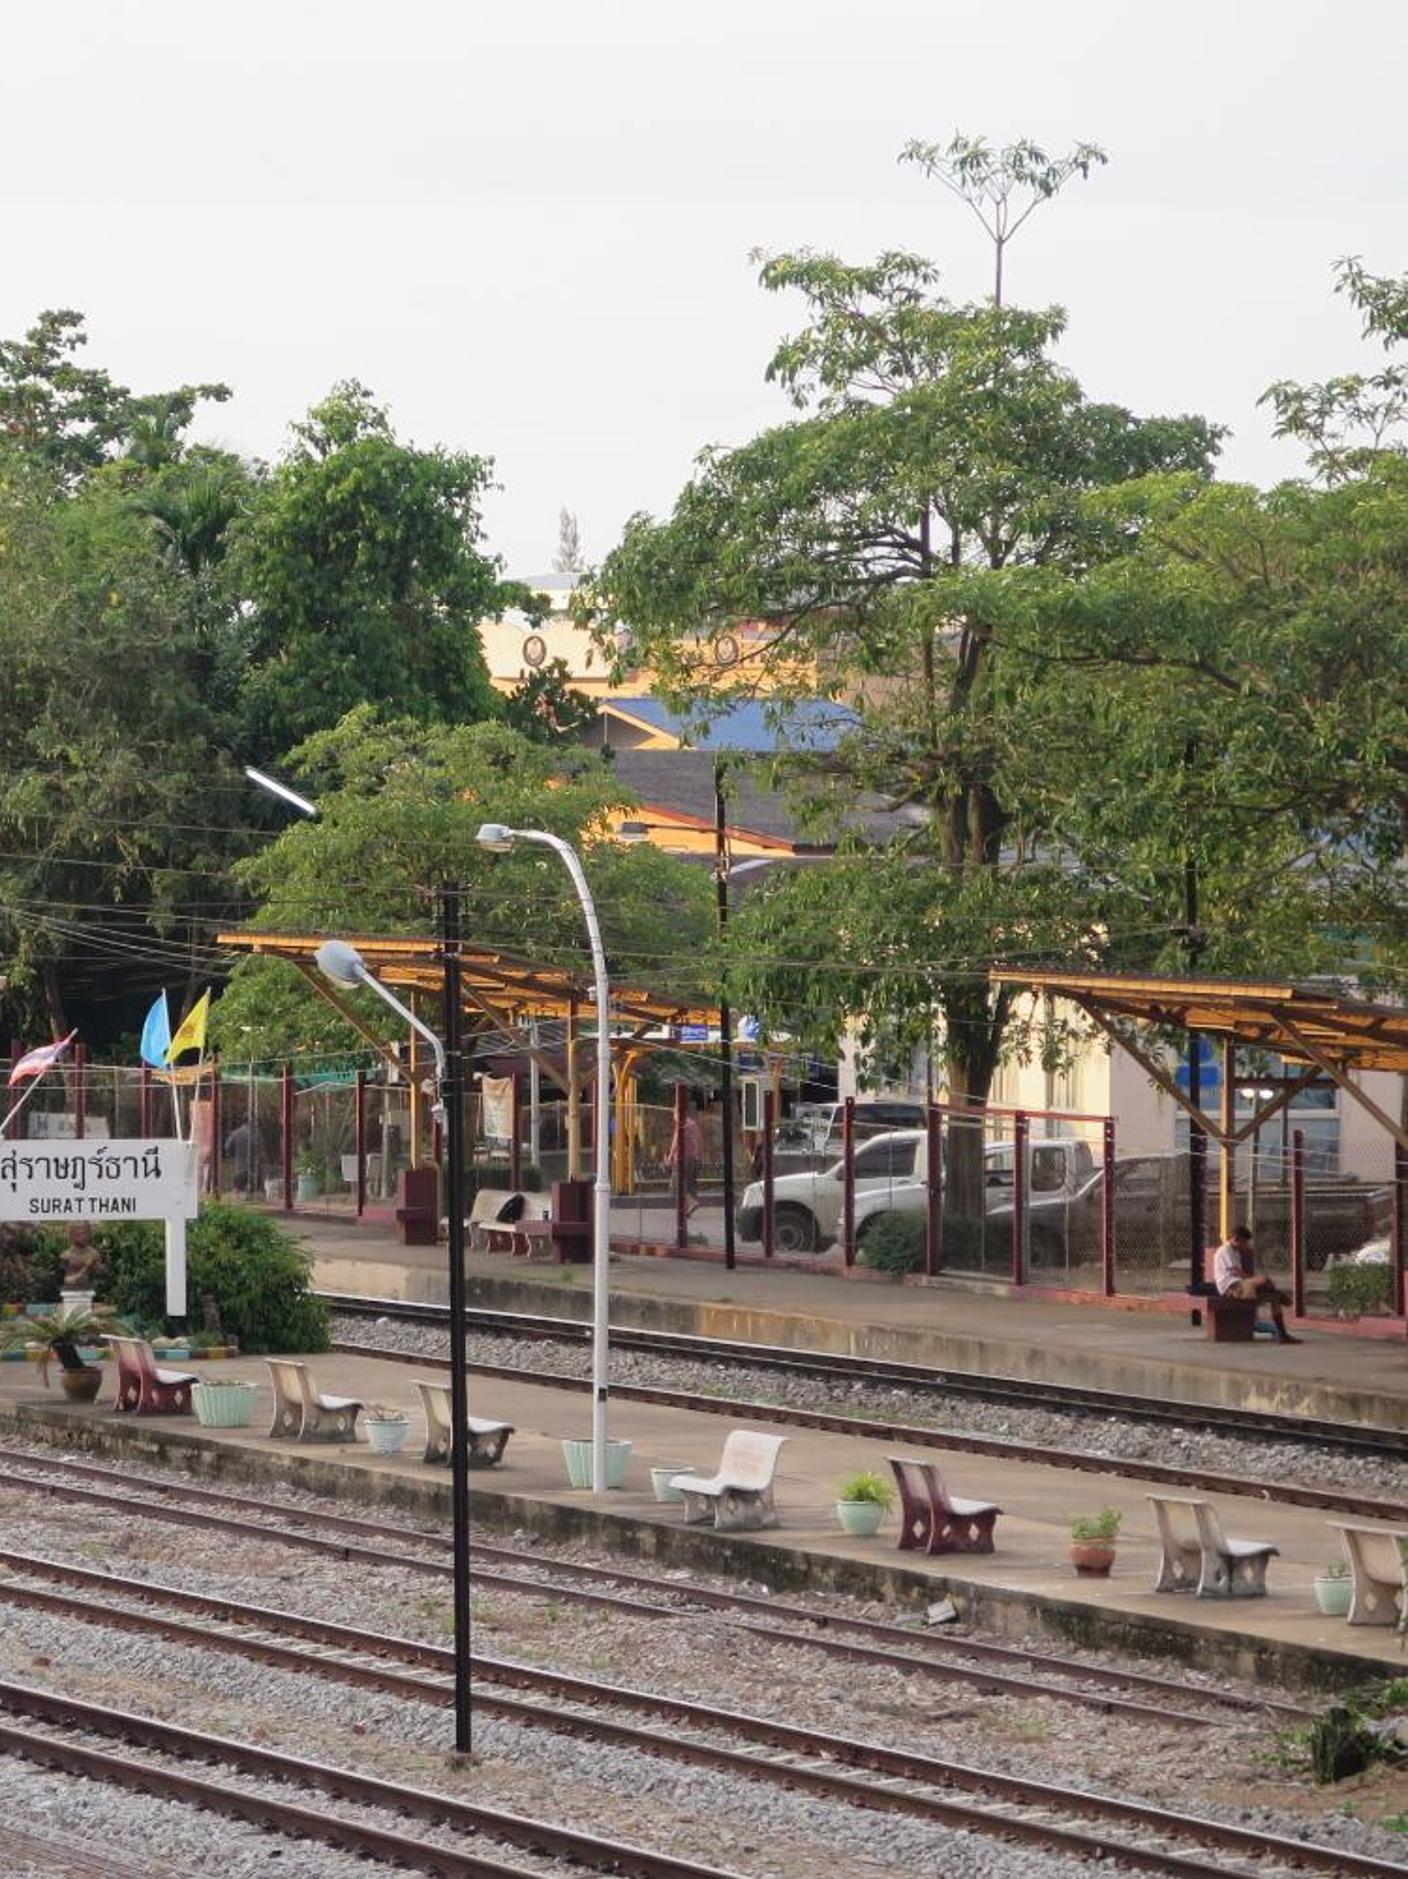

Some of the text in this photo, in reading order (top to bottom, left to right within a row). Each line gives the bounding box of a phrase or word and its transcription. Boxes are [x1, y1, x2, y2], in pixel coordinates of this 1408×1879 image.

[0, 1145, 162, 1193] สุราษฎร์ธานี
[29, 1197, 137, 1214] SURAT THANI
